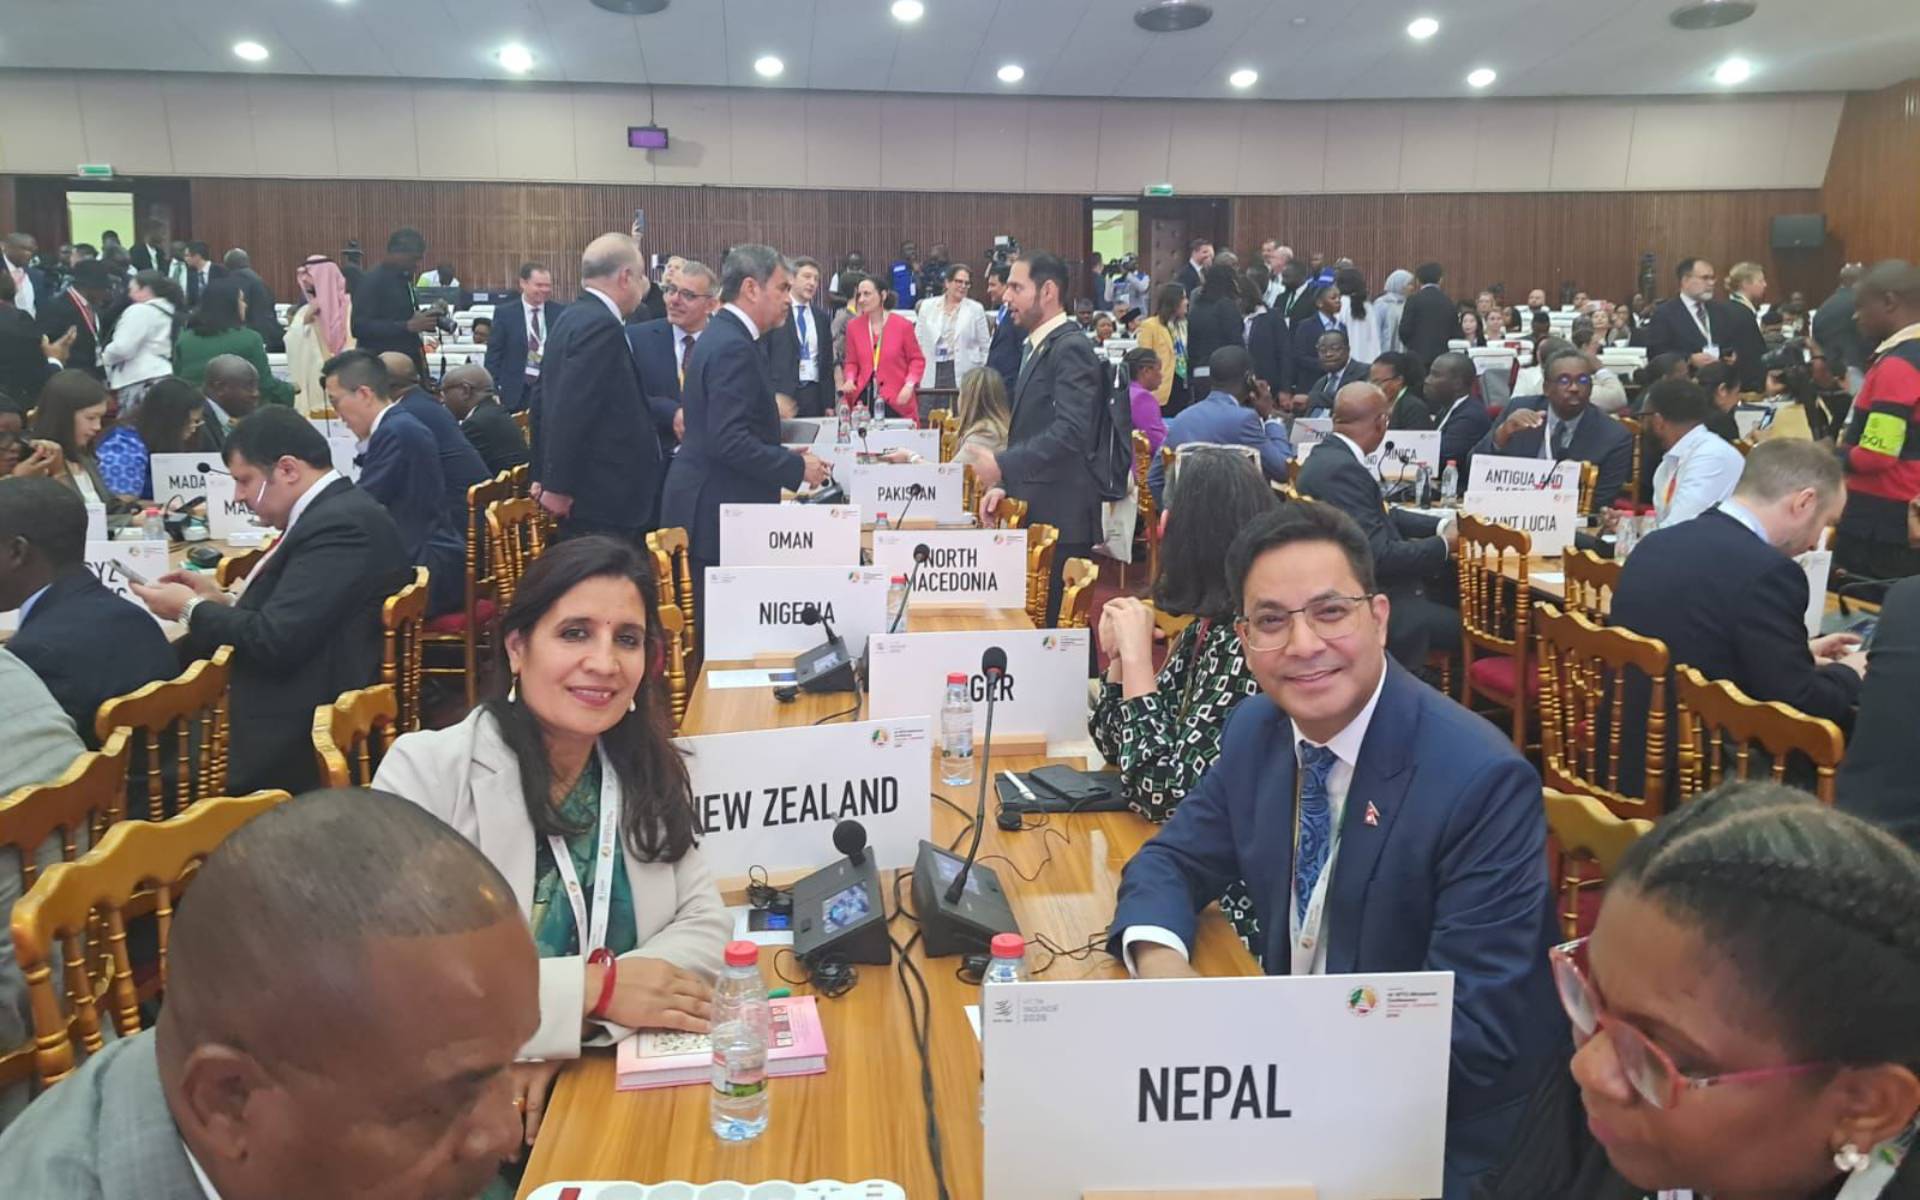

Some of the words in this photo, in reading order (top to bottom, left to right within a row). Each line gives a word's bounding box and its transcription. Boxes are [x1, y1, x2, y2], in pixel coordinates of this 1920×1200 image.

[169, 475, 207, 489] MADA
[1485, 469, 1535, 487] ANTIGUA
[1522, 515, 1557, 532] LUCIA
[769, 531, 813, 549] OMAN
[923, 548, 977, 568] NORTH
[904, 571, 998, 592] MACEDONIA
[970, 674, 1014, 702] GER
[762, 776, 899, 827] ZEALAND
[1138, 1063, 1292, 1123] NEPAL
